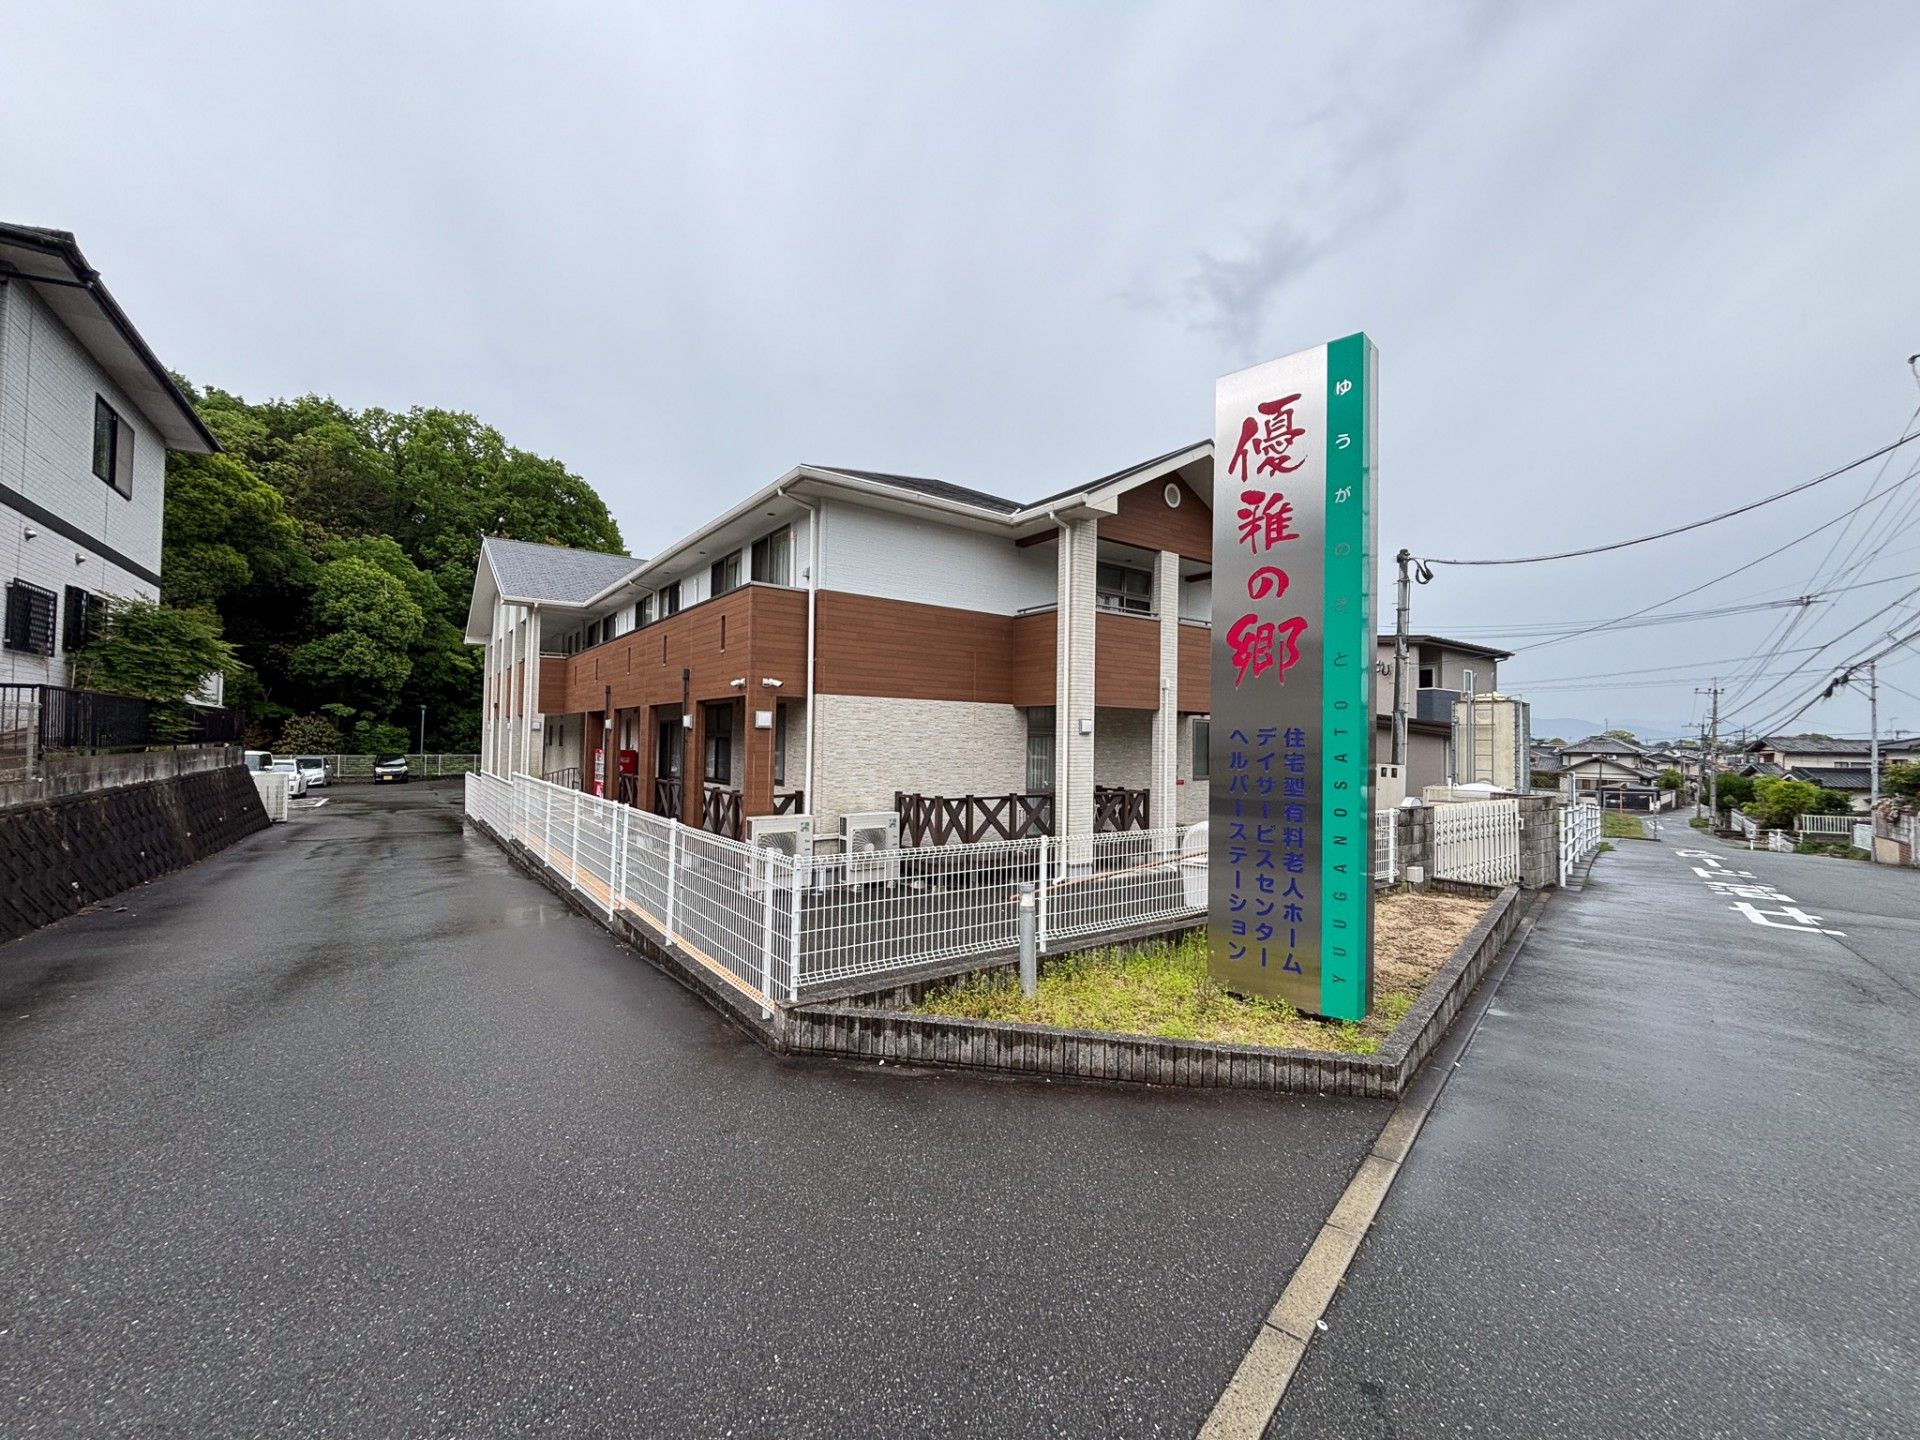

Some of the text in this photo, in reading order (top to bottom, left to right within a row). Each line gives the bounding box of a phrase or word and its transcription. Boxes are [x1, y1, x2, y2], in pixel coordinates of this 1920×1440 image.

[1226, 393, 1307, 690] 優雅の郷
[1229, 729, 1249, 960] ヘルパーステーション
[1256, 727, 1276, 968] デイサービスセンター
[1283, 727, 1305, 975] 住宅型有料老人ホーム
